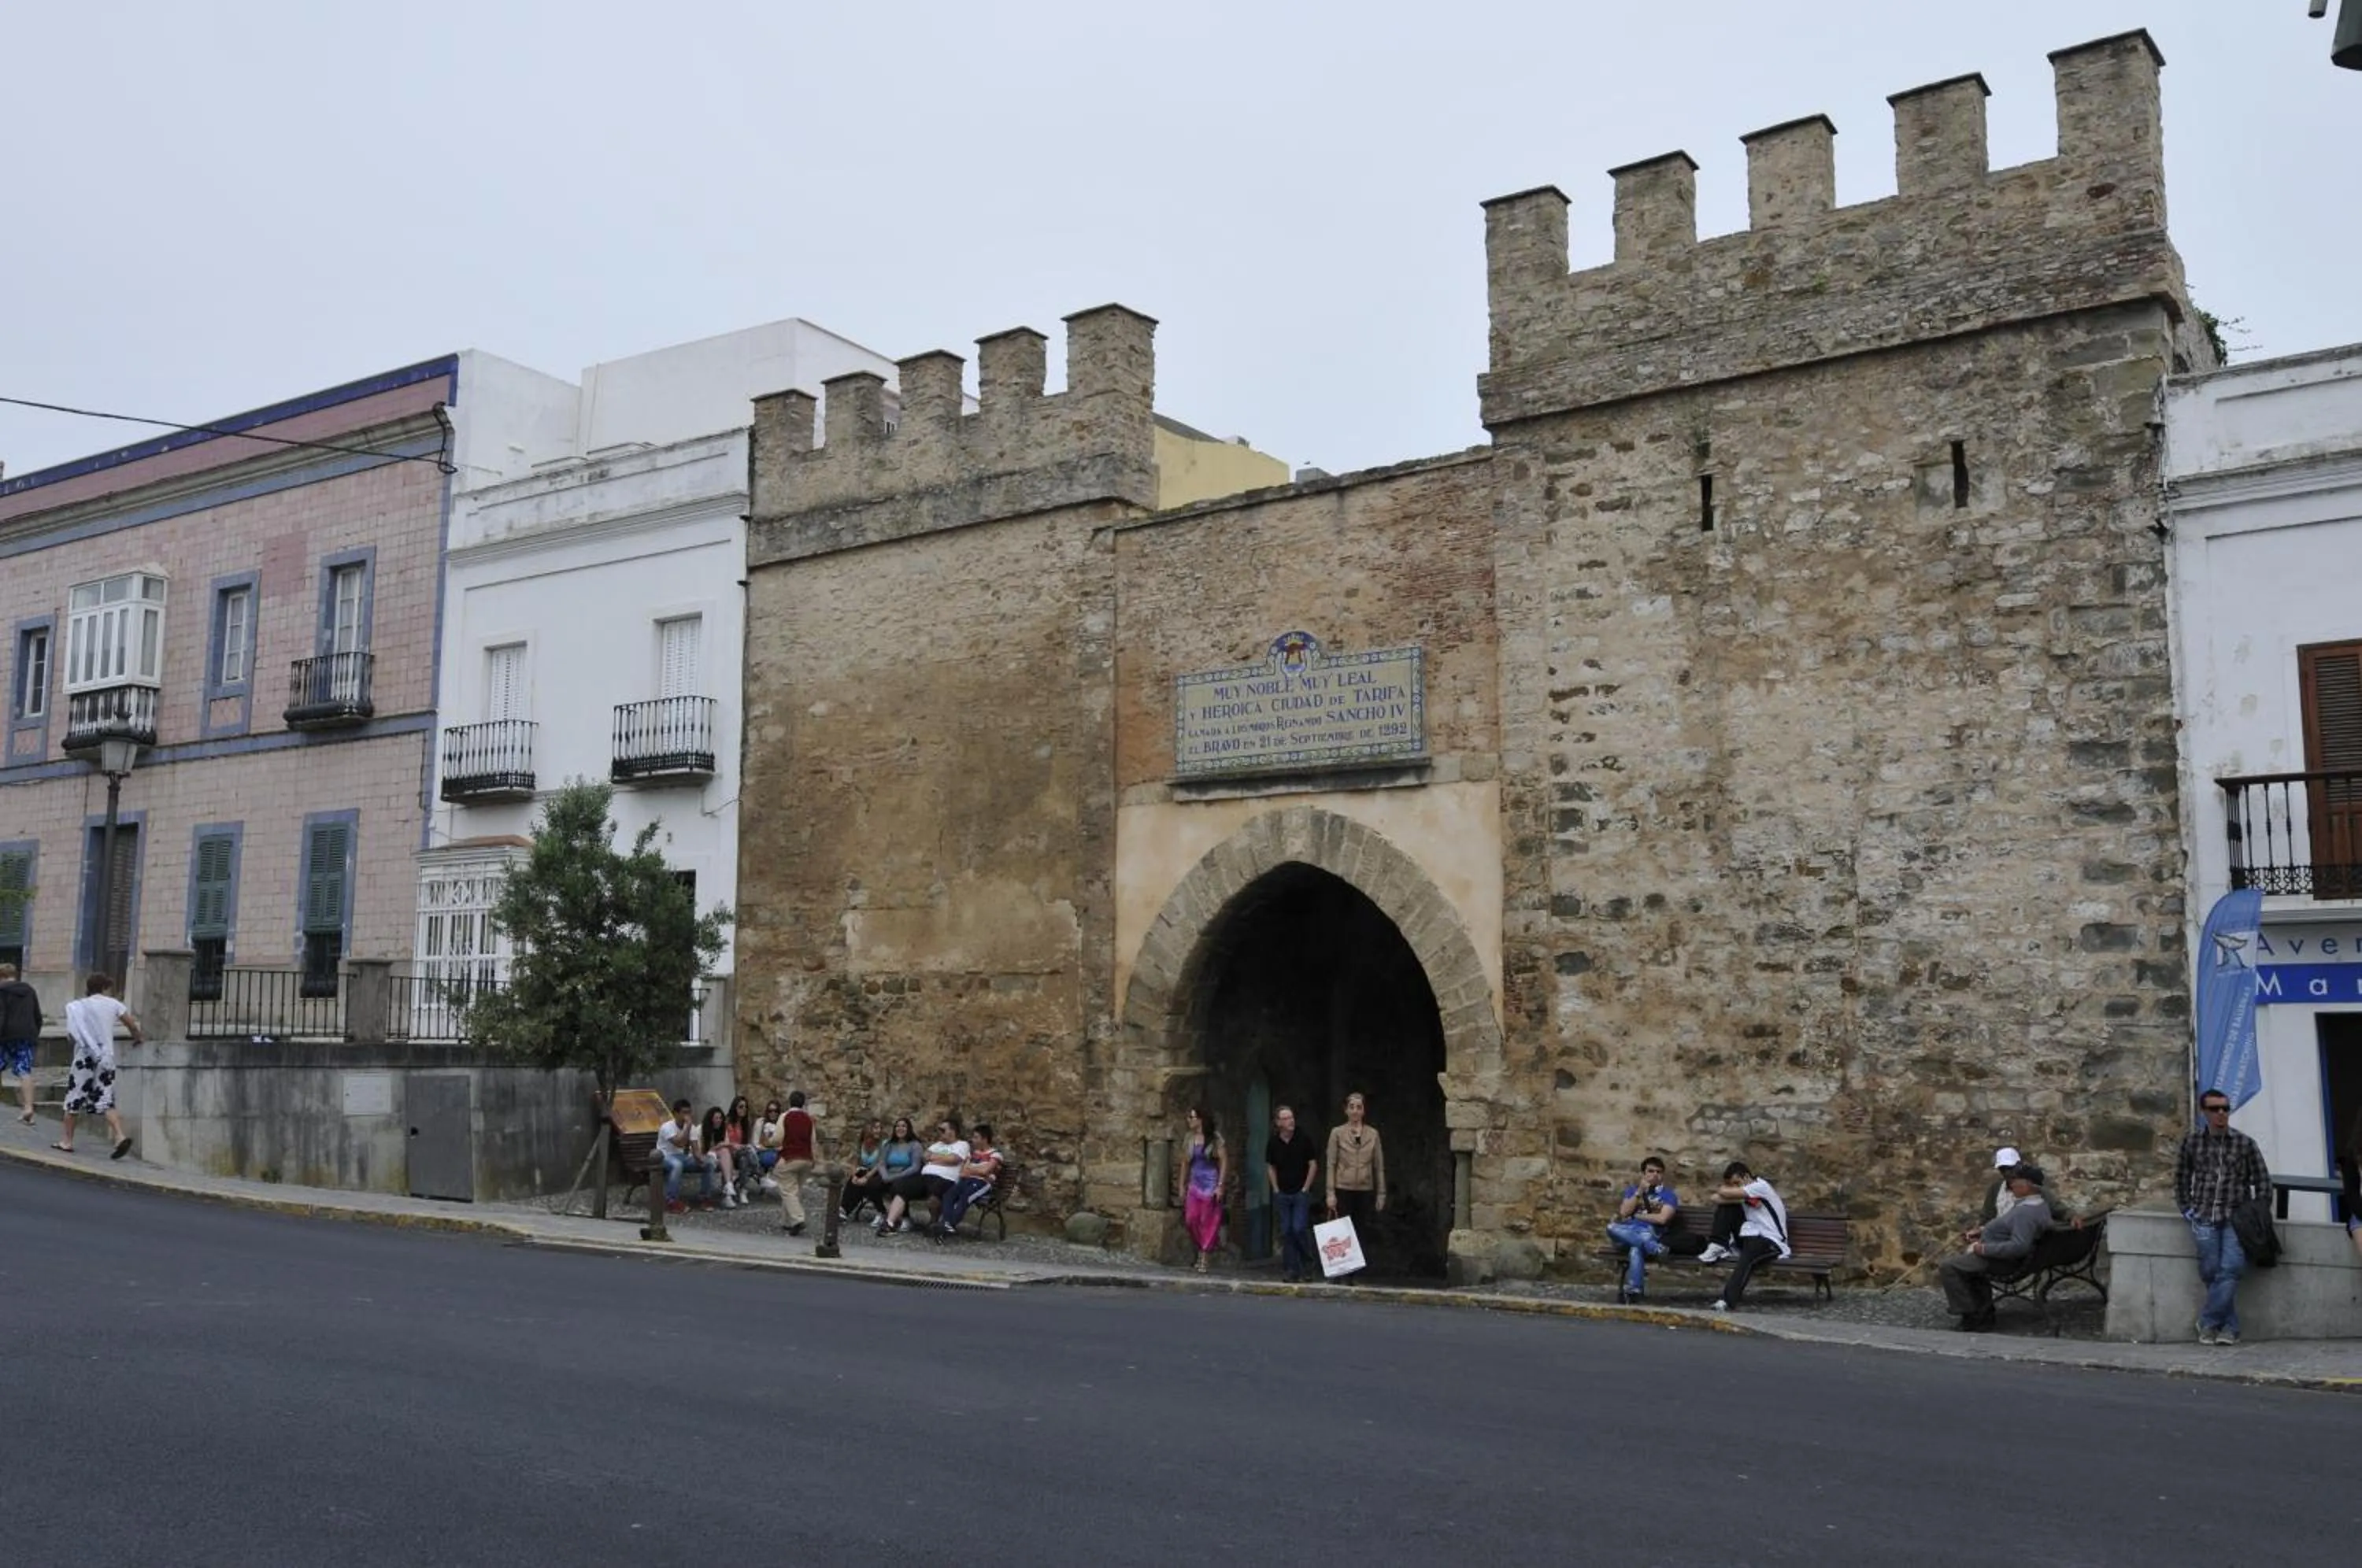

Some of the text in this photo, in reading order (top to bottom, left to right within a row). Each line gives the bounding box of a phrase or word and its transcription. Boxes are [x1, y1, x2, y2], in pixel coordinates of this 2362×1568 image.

[1214, 671, 1377, 701] MUY NOBLE MUY LEAL
[1202, 701, 1263, 719] HEROICA
[1272, 693, 1324, 712] CIUDAD
[1330, 695, 1346, 706] DE
[1353, 686, 1406, 703] TARIFA
[1326, 704, 1386, 723] SANCHO
[1390, 704, 1406, 719] IV
[1204, 738, 1240, 754] BRAVO
[1260, 735, 1271, 749] 21
[1359, 728, 1374, 738] DE
[1379, 722, 1408, 737] 1292
